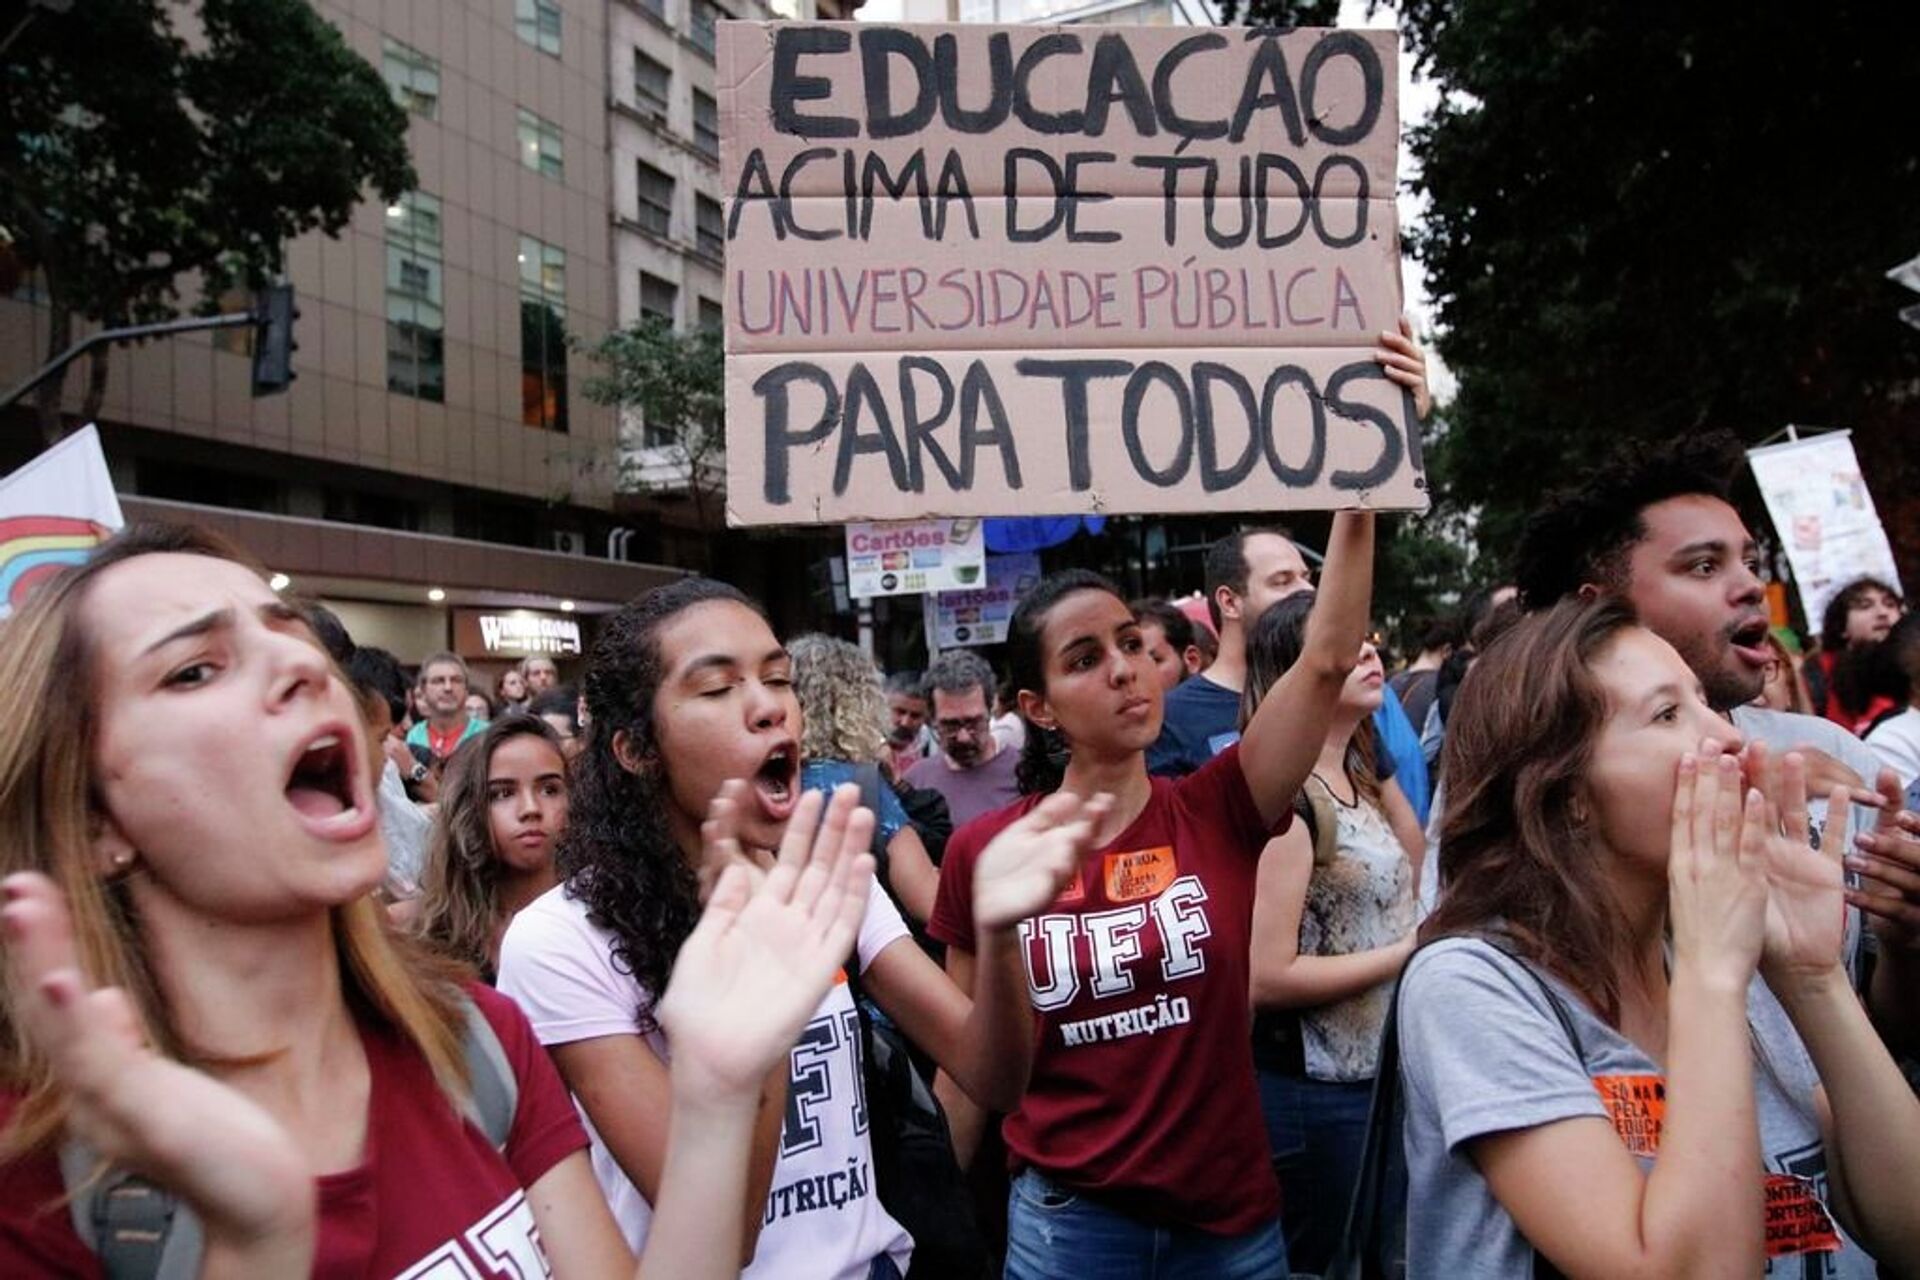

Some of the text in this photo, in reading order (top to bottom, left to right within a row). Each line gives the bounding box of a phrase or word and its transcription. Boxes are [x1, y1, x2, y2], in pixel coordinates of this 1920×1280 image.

[771, 27, 1384, 152] EDUCAÇÃO
[728, 148, 979, 242] ACIMA
[1004, 148, 1122, 244] DE
[738, 256, 1367, 336] UNIVERSIDADE PÚBLICA
[752, 355, 1023, 505] PARA
[852, 529, 945, 553] Cartões
[1017, 875, 1212, 1012] UFF
[1060, 992, 1191, 1047] NUTRIÇÃO
[1613, 1101, 1650, 1118] PELA
[1616, 1119, 1663, 1135] EDUCA
[764, 1156, 869, 1225] UTRIÇÃ
